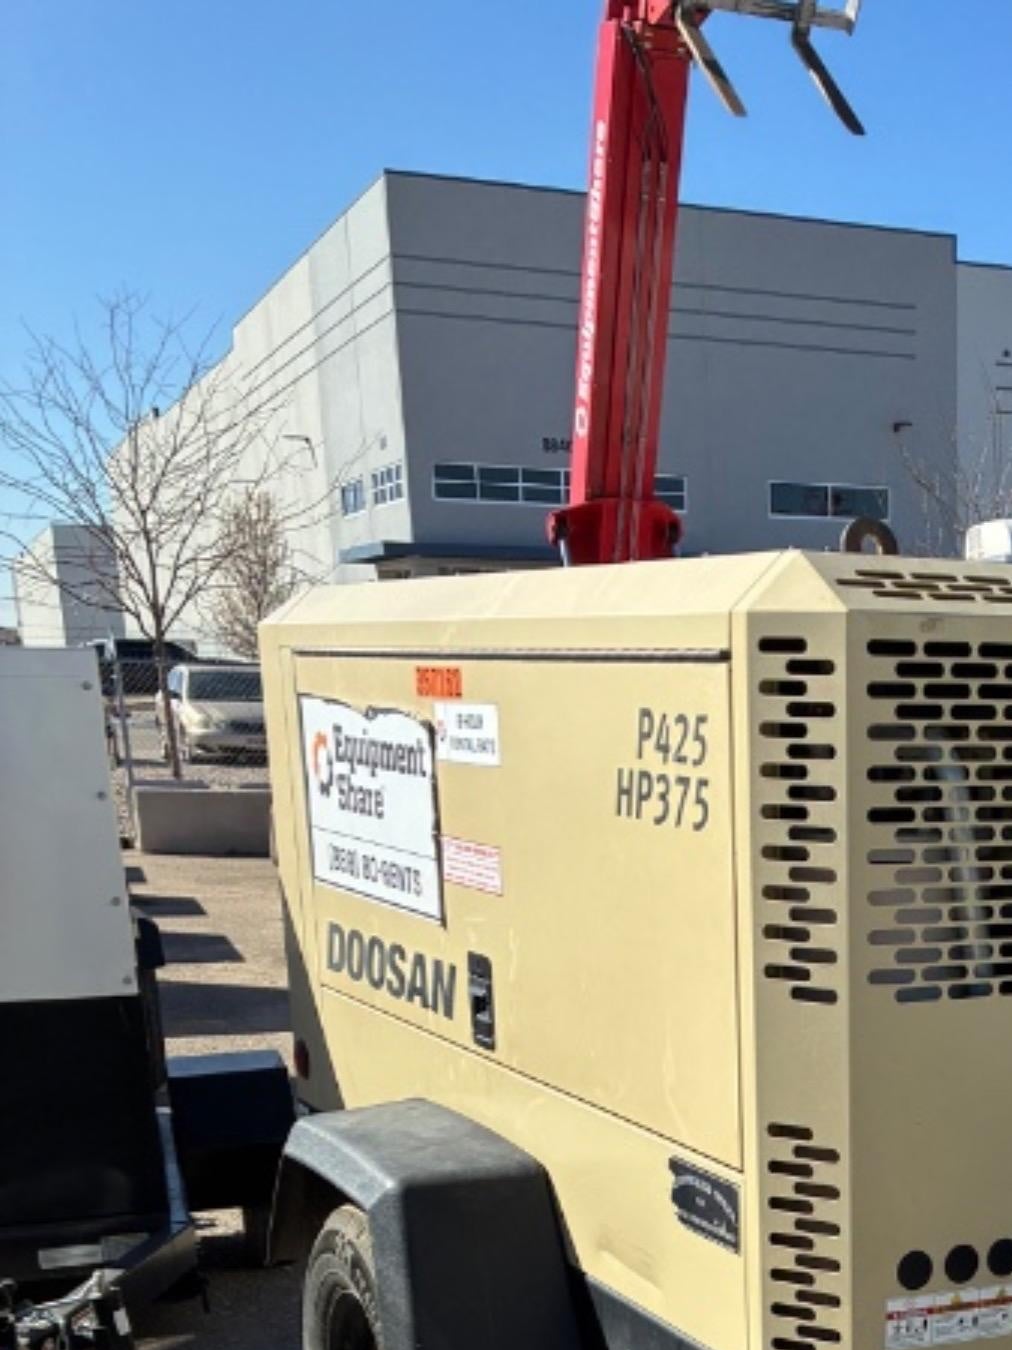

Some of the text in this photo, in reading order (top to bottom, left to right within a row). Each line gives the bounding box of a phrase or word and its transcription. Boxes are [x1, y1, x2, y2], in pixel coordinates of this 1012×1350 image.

[332, 722, 427, 778] Equipment
[636, 707, 709, 767] P425
[336, 773, 385, 820] Share
[615, 767, 710, 832] HP375
[326, 922, 457, 1021] DOOSAN
